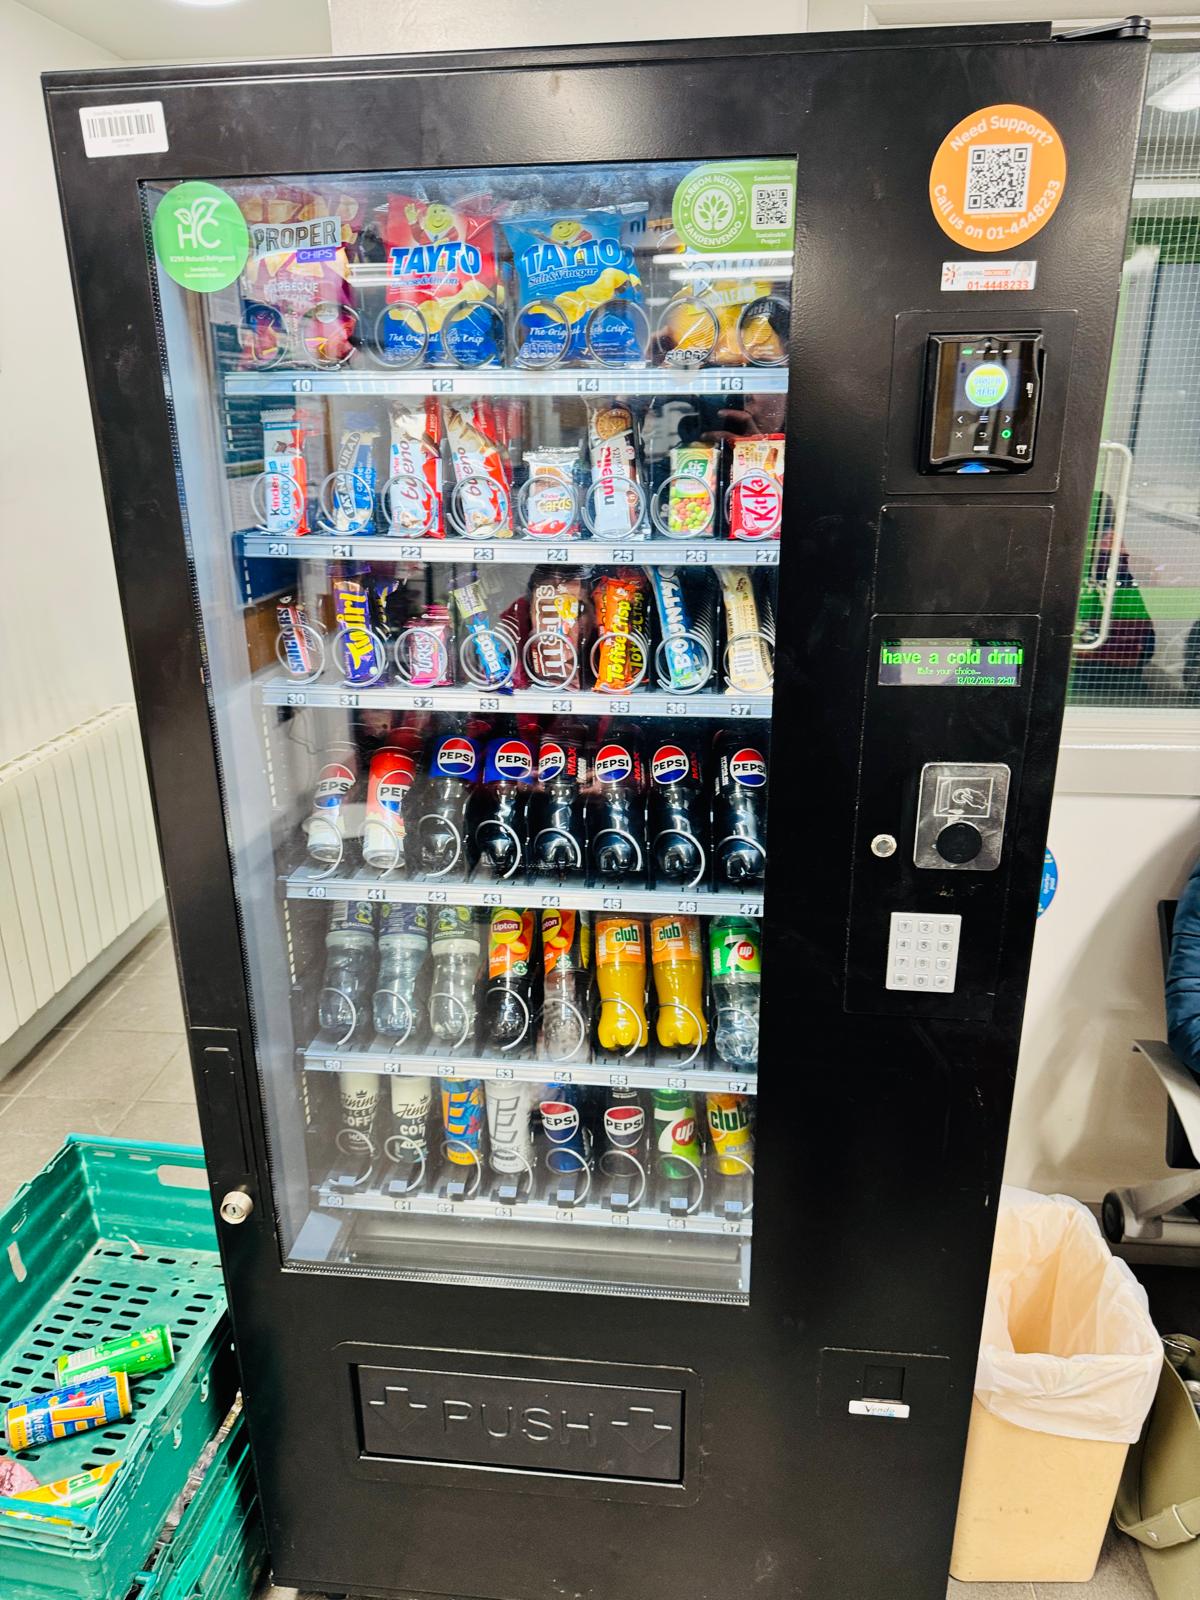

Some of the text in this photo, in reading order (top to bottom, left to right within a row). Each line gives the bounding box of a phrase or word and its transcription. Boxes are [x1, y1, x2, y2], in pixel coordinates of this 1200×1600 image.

[950, 115, 1054, 152] Need Support?
[683, 175, 746, 208] CARBON NEUTRAL
[933, 180, 1061, 240] Call us on 01-4448233
[252, 219, 338, 254] PROPER
[685, 220, 742, 246] SANDENVENDO
[300, 250, 333, 261] CHIPS
[389, 241, 482, 277] TAYTO
[521, 237, 623, 277] TAYTO
[968, 280, 1029, 290] 01-4448233
[530, 326, 547, 336] The
[292, 380, 312, 392] 10
[432, 380, 452, 392] 12
[579, 379, 599, 392] 14
[722, 378, 743, 390] 16
[270, 475, 280, 516] Kinder
[742, 478, 777, 522] KitKa
[270, 544, 288, 555] 20
[334, 546, 350, 557] 21
[402, 546, 420, 558] 22
[474, 548, 492, 560] 23
[548, 550, 568, 561] 24
[614, 550, 634, 562] 25
[686, 550, 706, 562] 26
[756, 551, 776, 562] 27
[660, 580, 692, 669] BOUNTY
[336, 593, 374, 670] Twirl
[276, 608, 306, 673] SNICKRS
[606, 600, 631, 682] Toffee Crisp
[882, 648, 922, 664] have
[929, 652, 939, 664] a
[947, 648, 981, 664] cold
[288, 694, 304, 704] 30
[340, 696, 358, 706] 31
[414, 698, 432, 708] 32
[480, 700, 498, 710] 33
[552, 701, 572, 712] 34
[610, 702, 628, 712] 35
[666, 703, 686, 714] 36
[731, 704, 750, 715] 37
[440, 750, 473, 764] PEPSI
[498, 754, 531, 767] PEPSI
[540, 756, 562, 768] EPSI
[567, 746, 577, 777] MAX
[597, 758, 629, 770] PEPSI
[654, 758, 686, 772] PEPSI
[690, 752, 699, 780] MAX
[319, 781, 350, 793] EPS
[380, 786, 409, 797] PEP
[308, 888, 325, 898] 40
[368, 890, 384, 899] 41
[429, 892, 446, 902] 42
[484, 894, 501, 904] 43
[542, 896, 559, 906] 44
[604, 899, 621, 909] 45
[680, 902, 697, 912] 46
[741, 904, 758, 914] 47
[494, 922, 518, 932] Lipton
[658, 922, 681, 940] club
[614, 925, 639, 942] club
[324, 1060, 341, 1070] 50
[385, 1064, 400, 1072] 51
[438, 1066, 454, 1075] 52
[496, 1069, 512, 1078] 53
[554, 1072, 572, 1082] 54
[610, 1075, 626, 1084] 55
[668, 1078, 685, 1088] 56
[730, 1082, 746, 1092] 57
[710, 1101, 749, 1132] club
[442, 1400, 596, 1447] PUSH
